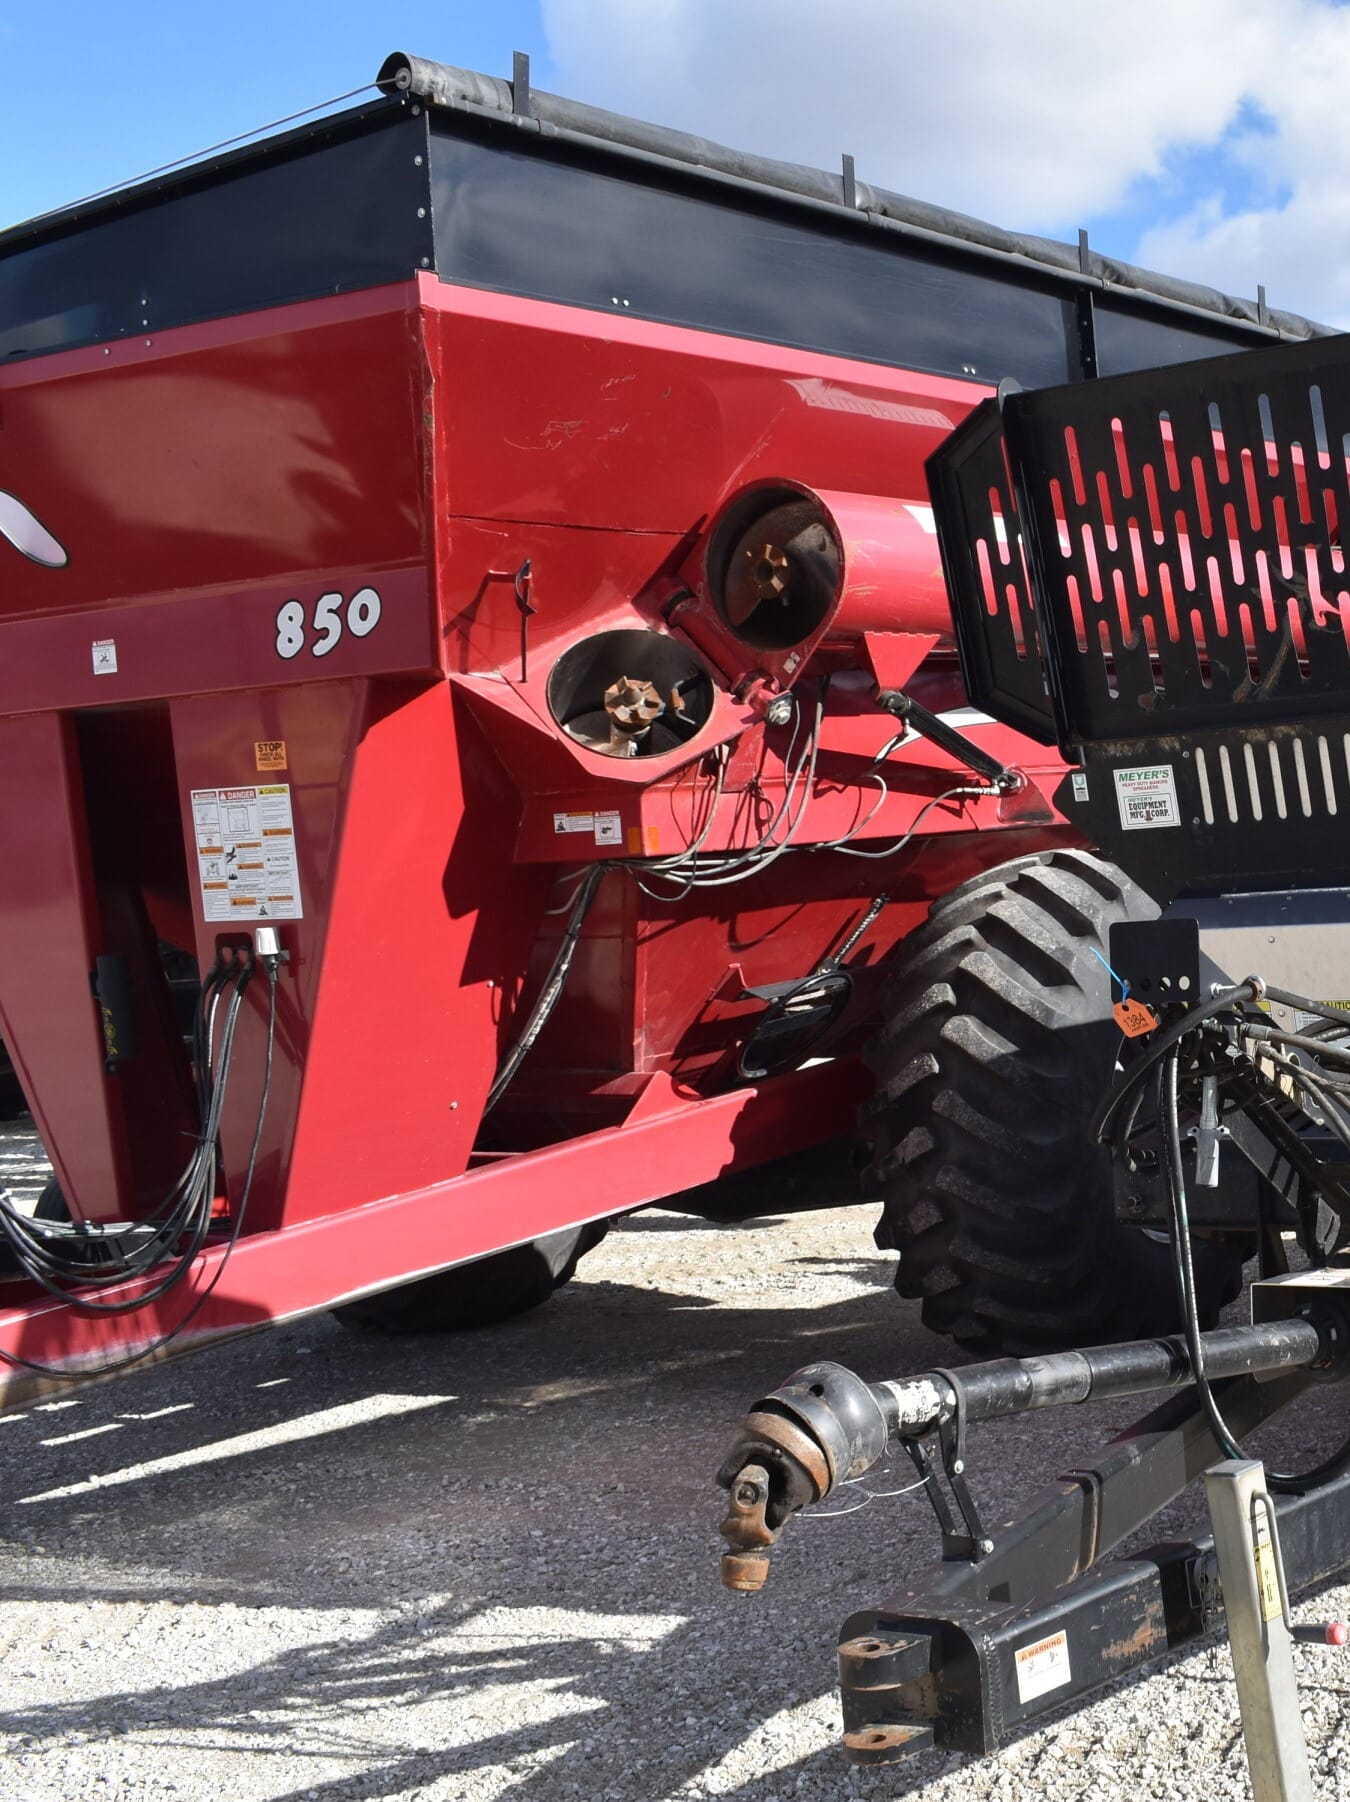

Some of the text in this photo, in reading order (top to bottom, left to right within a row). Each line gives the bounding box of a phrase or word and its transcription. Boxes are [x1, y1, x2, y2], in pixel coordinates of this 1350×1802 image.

[275, 585, 382, 660] 850
[258, 742, 283, 752] STOP!
[1118, 769, 1169, 782] MEYER'S
[227, 790, 255, 800] DANGER
[1128, 800, 1167, 810] EQUIPMENT
[1151, 809, 1170, 817] CORP.
[1123, 1012, 1146, 1029] 1384
[1028, 1638, 1062, 1657] WARNING
